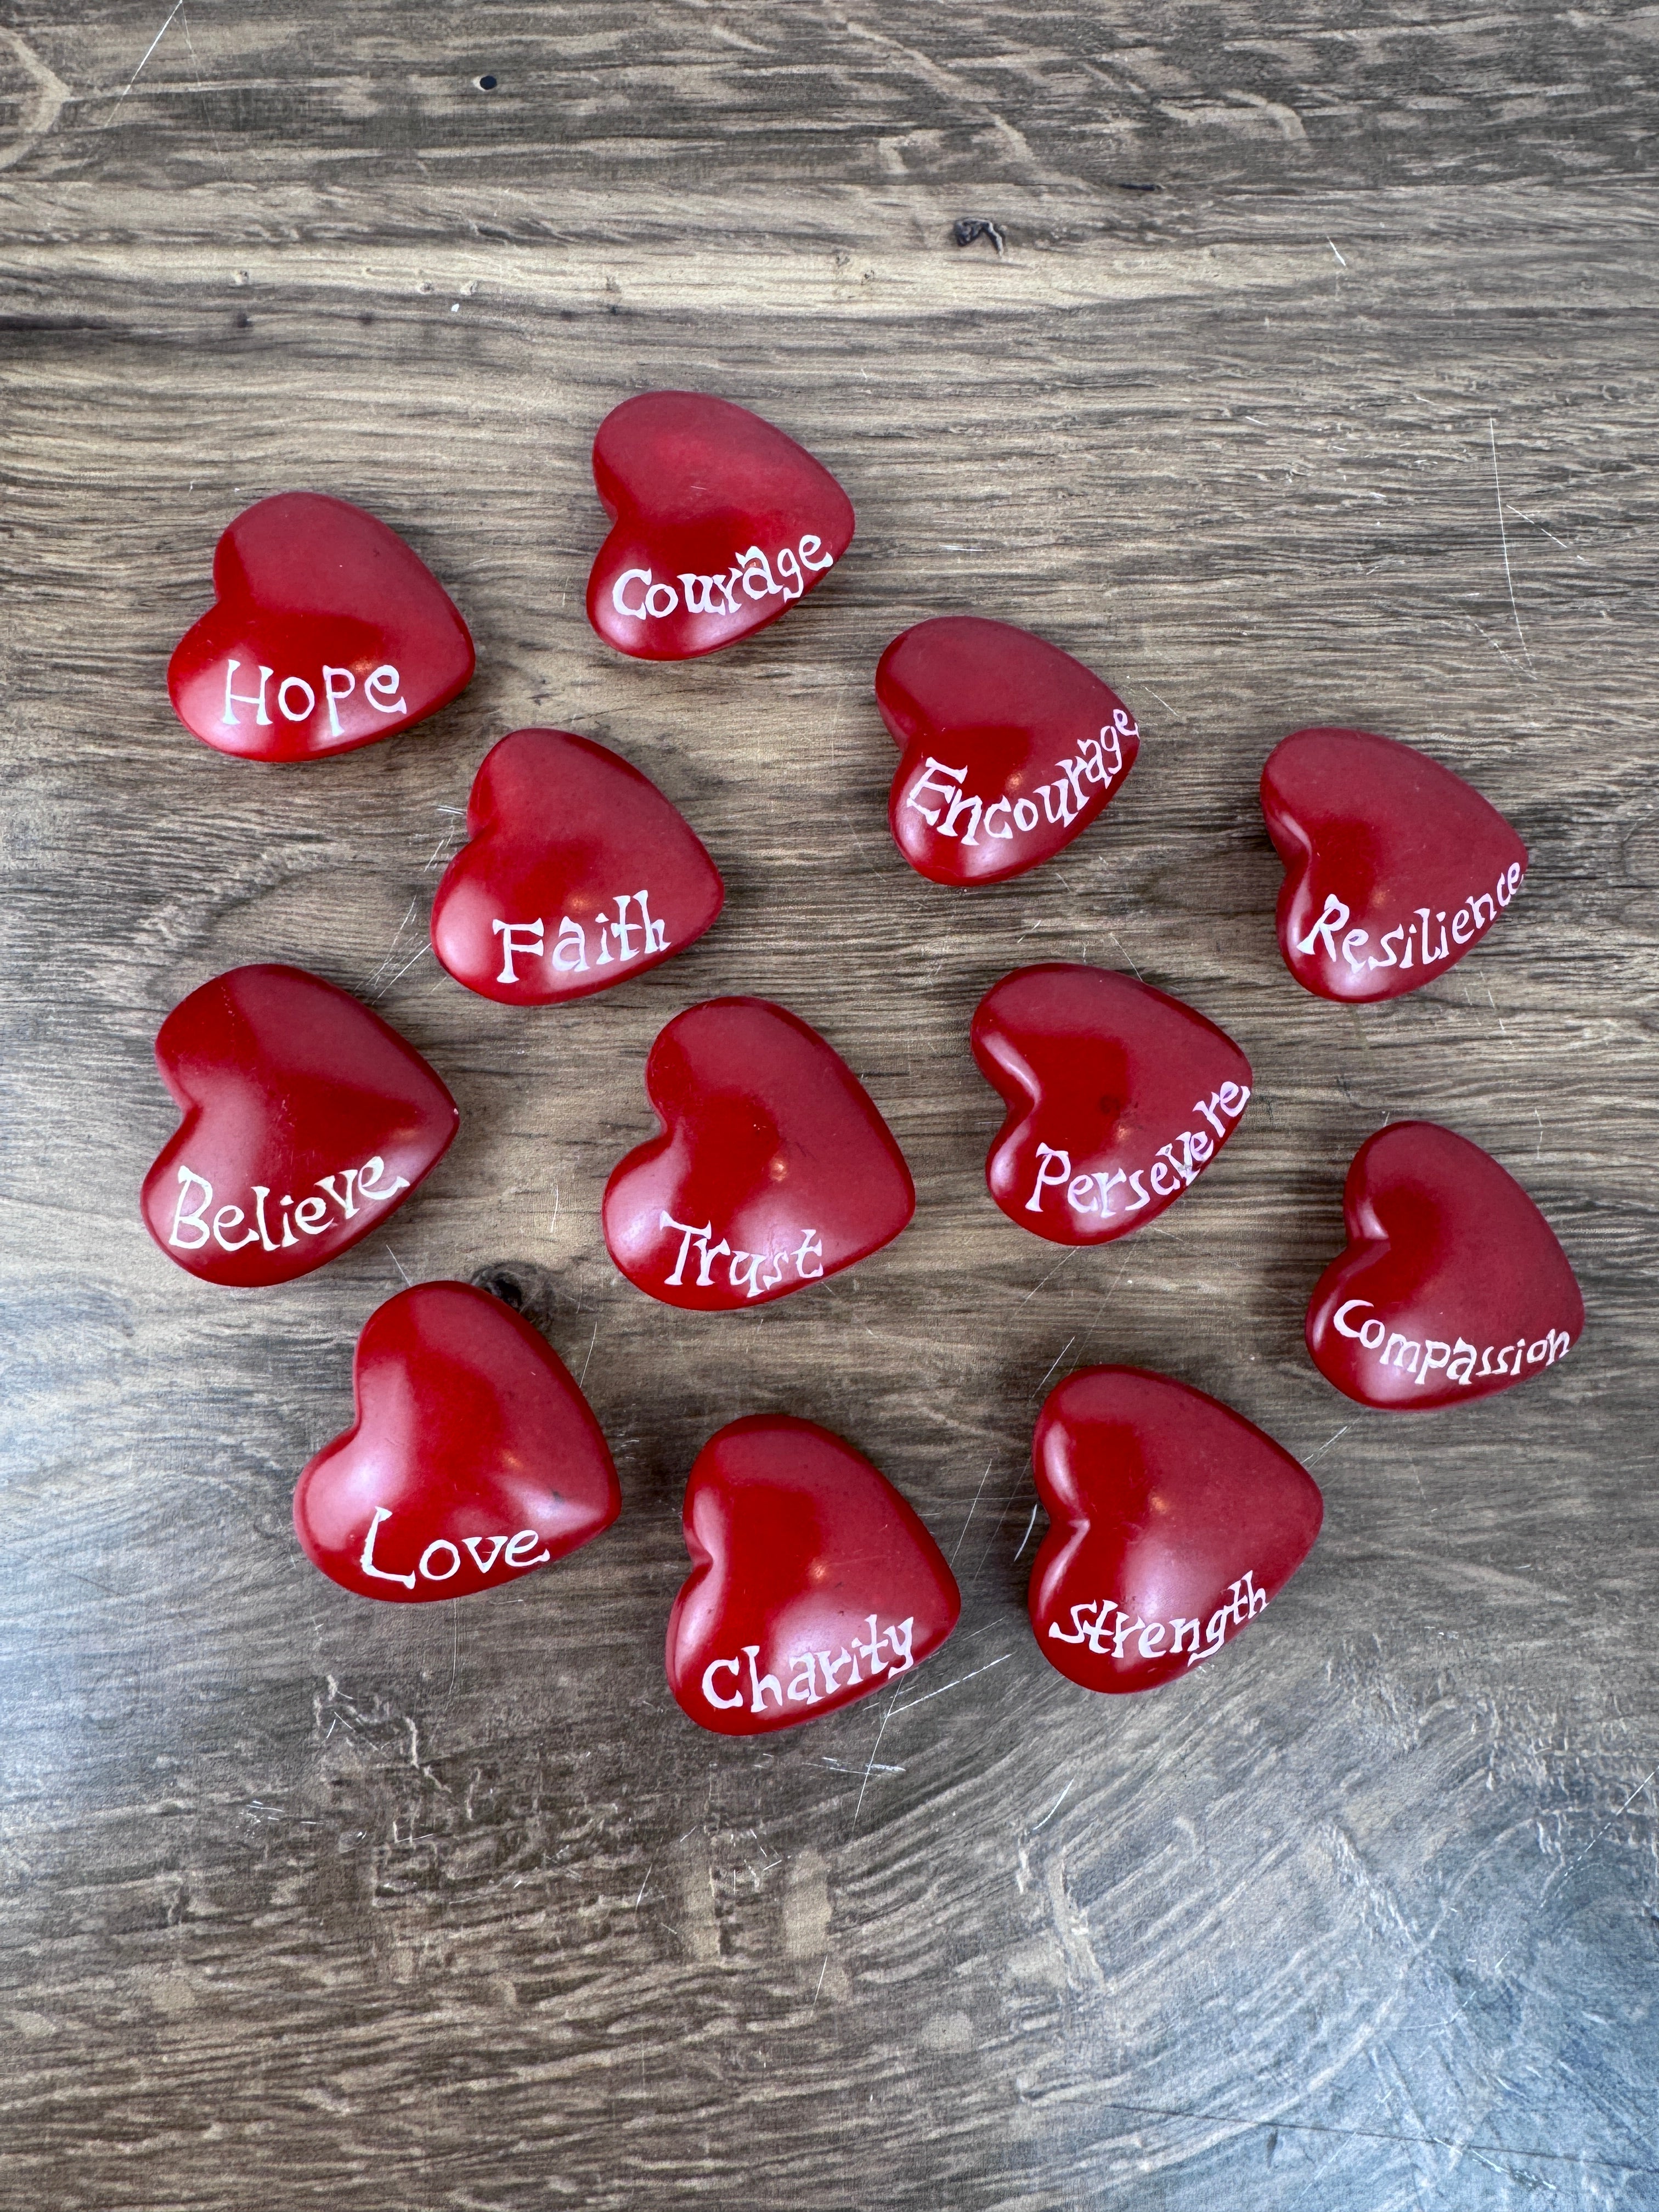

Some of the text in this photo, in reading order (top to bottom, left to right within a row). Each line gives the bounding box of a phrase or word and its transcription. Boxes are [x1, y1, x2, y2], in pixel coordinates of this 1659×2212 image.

[611, 534, 833, 620] Courage
[223, 658, 407, 735] Hope
[904, 708, 1141, 846] Encourage
[492, 889, 672, 984] Faith
[1296, 862, 1522, 973] Resilience
[1025, 1080, 1251, 1217] Persevere
[168, 1155, 410, 1251] Believe
[658, 1210, 823, 1298] Trust
[1333, 1299, 1570, 1385] Compassion
[360, 1507, 550, 1589] Love
[702, 1614, 915, 1713] Charity
[1048, 1570, 1269, 1667] Strength
